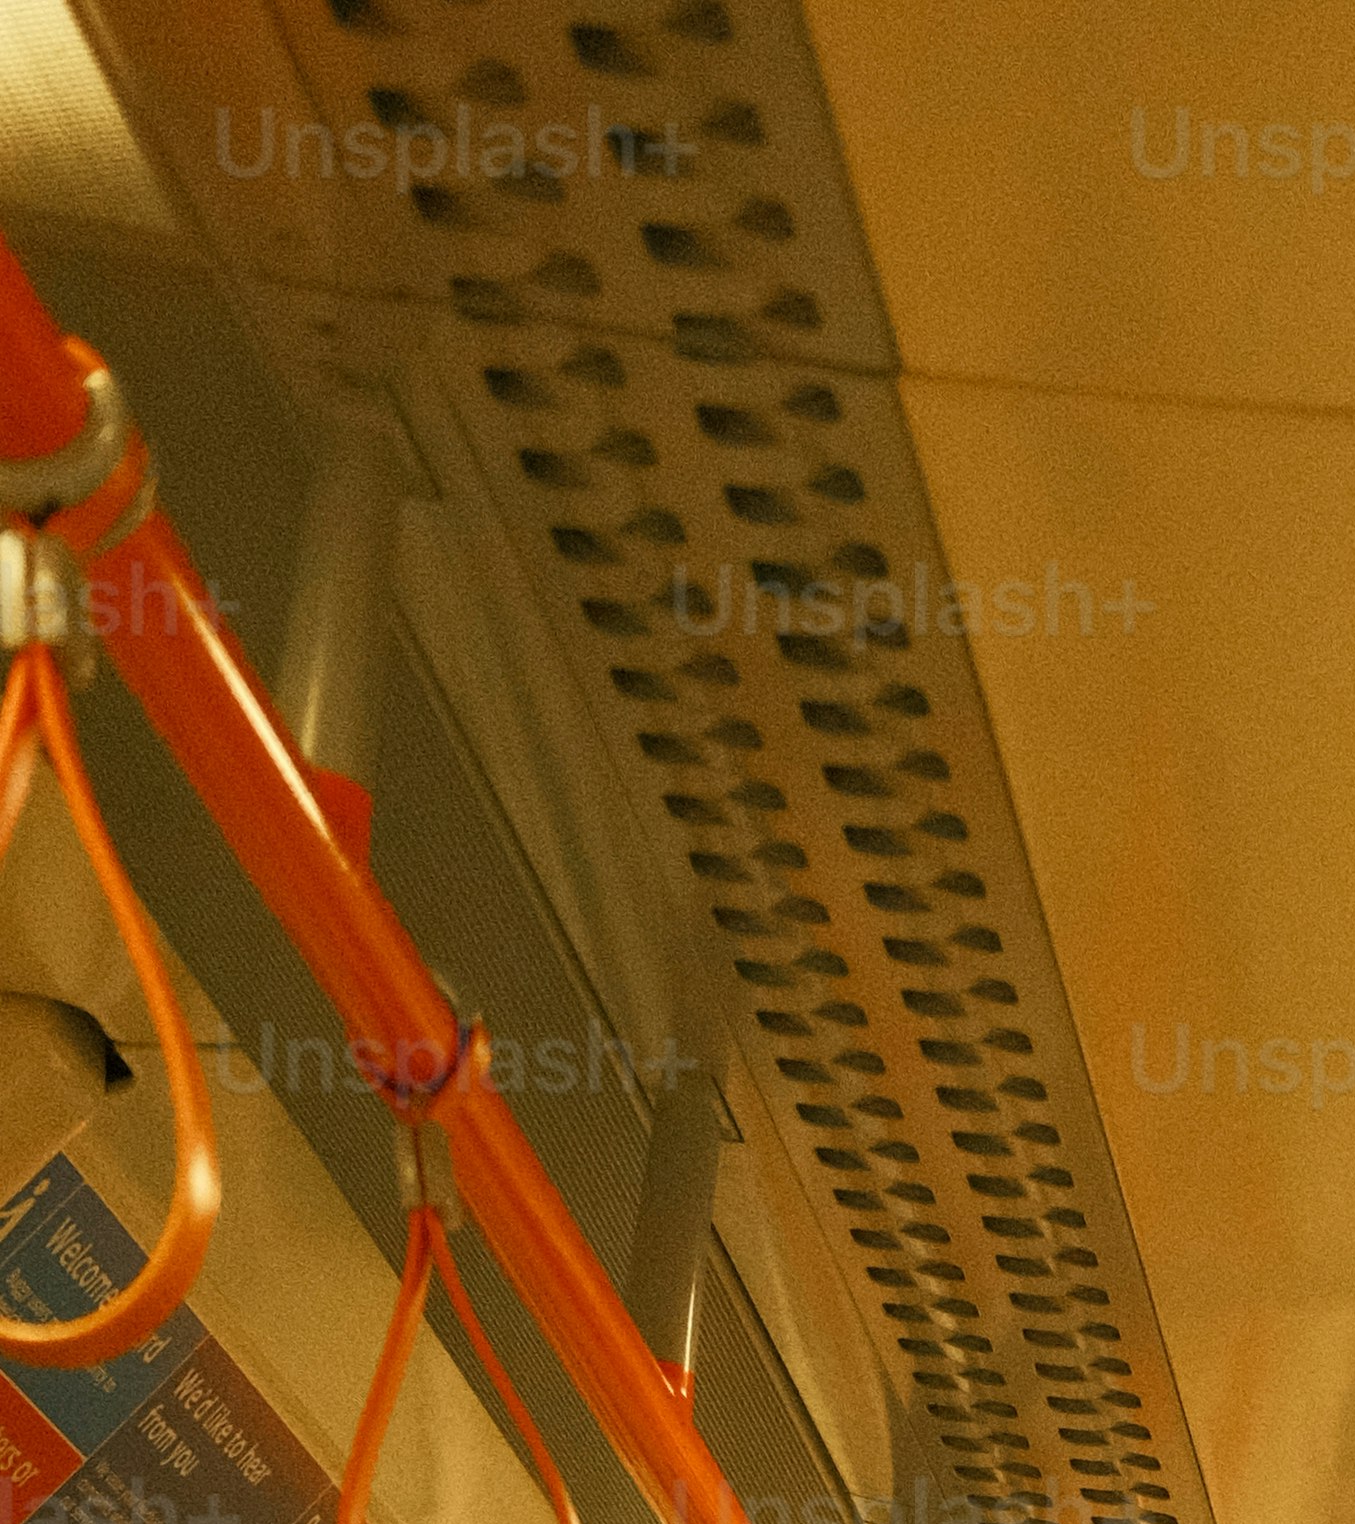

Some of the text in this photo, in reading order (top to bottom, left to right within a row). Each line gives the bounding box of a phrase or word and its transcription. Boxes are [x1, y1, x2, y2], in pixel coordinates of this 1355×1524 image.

[47, 1218, 119, 1303] Welcome
[137, 1404, 177, 1452] from
[160, 1443, 200, 1477] you
[173, 1369, 273, 1487] We'd like to hear
